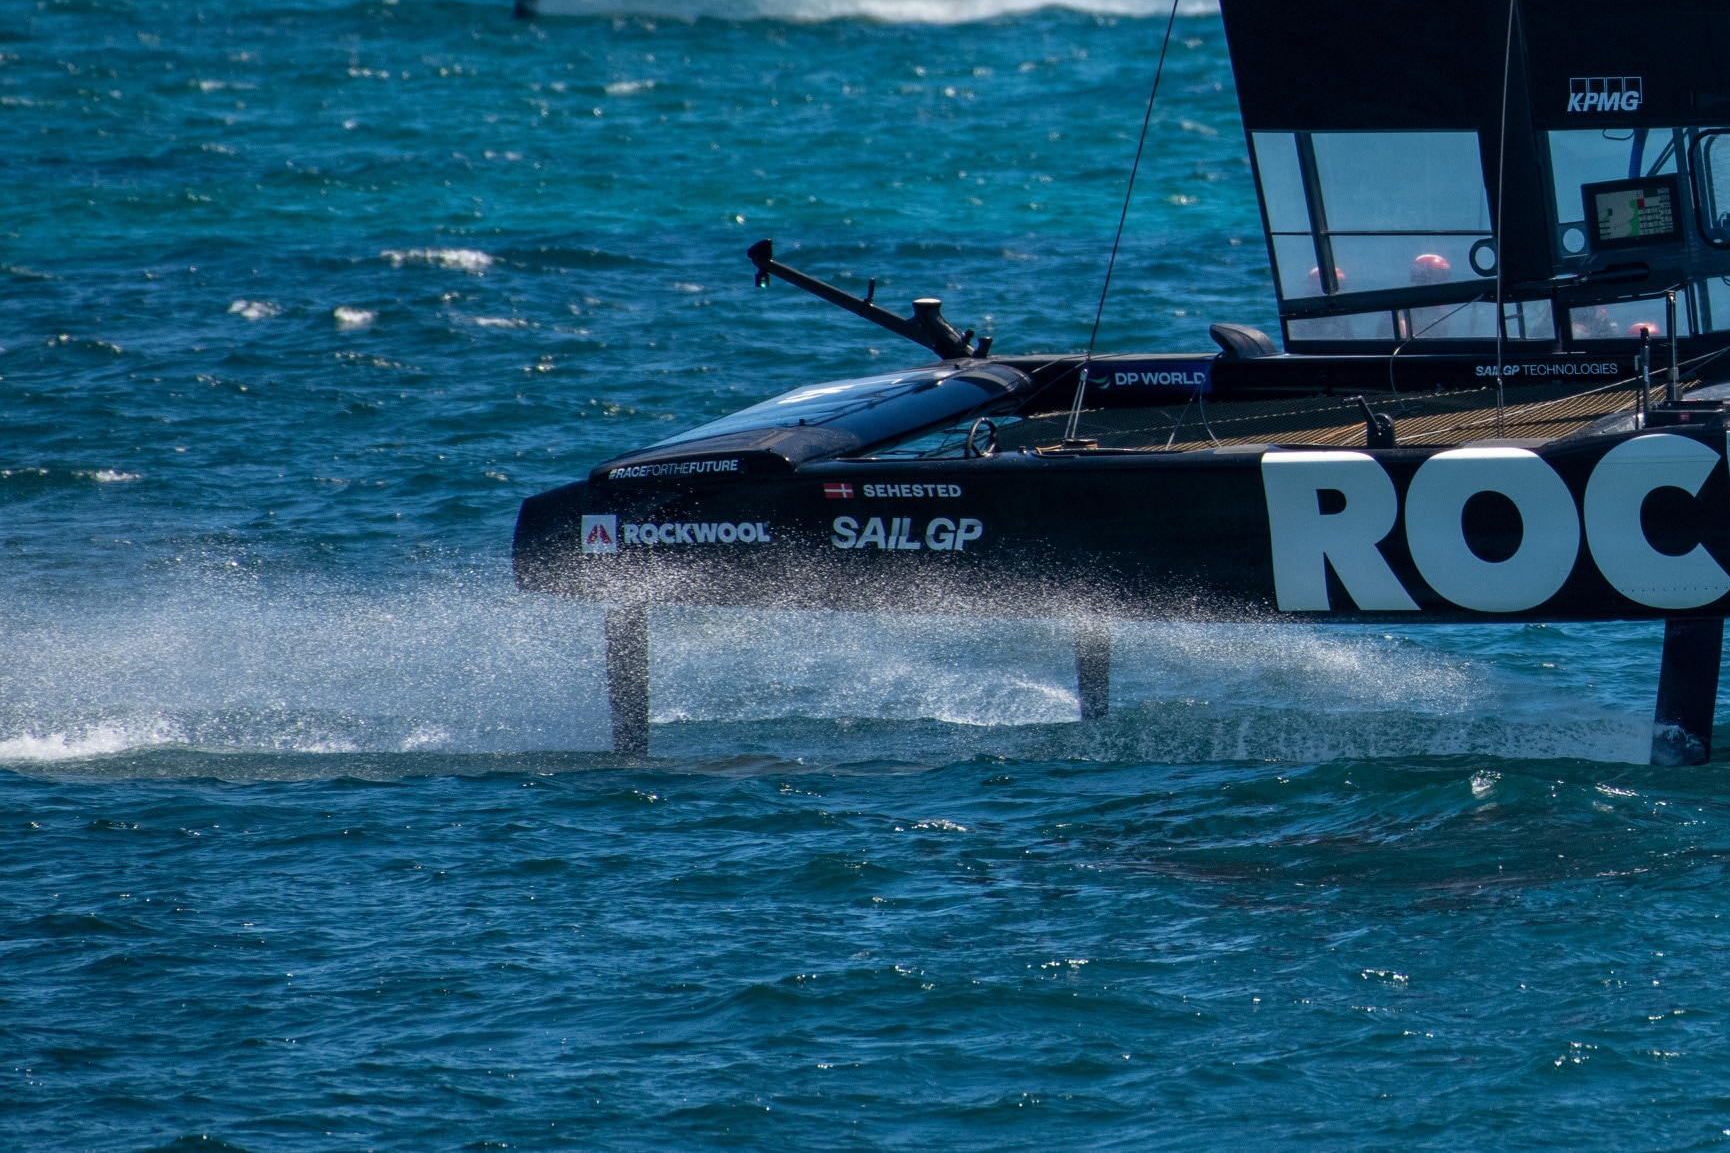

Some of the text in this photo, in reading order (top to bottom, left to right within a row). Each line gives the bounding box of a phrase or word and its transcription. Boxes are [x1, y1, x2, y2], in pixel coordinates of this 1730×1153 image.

[1567, 90, 1641, 112] KPMG
[1522, 363, 1618, 376] TECHNOLOGIES
[1115, 372, 1206, 385] DP WORLD
[608, 459, 739, 480] #RACEFORTHEFUTURE
[863, 484, 962, 497] SEHESTED
[623, 522, 771, 544] ROCKWOOL
